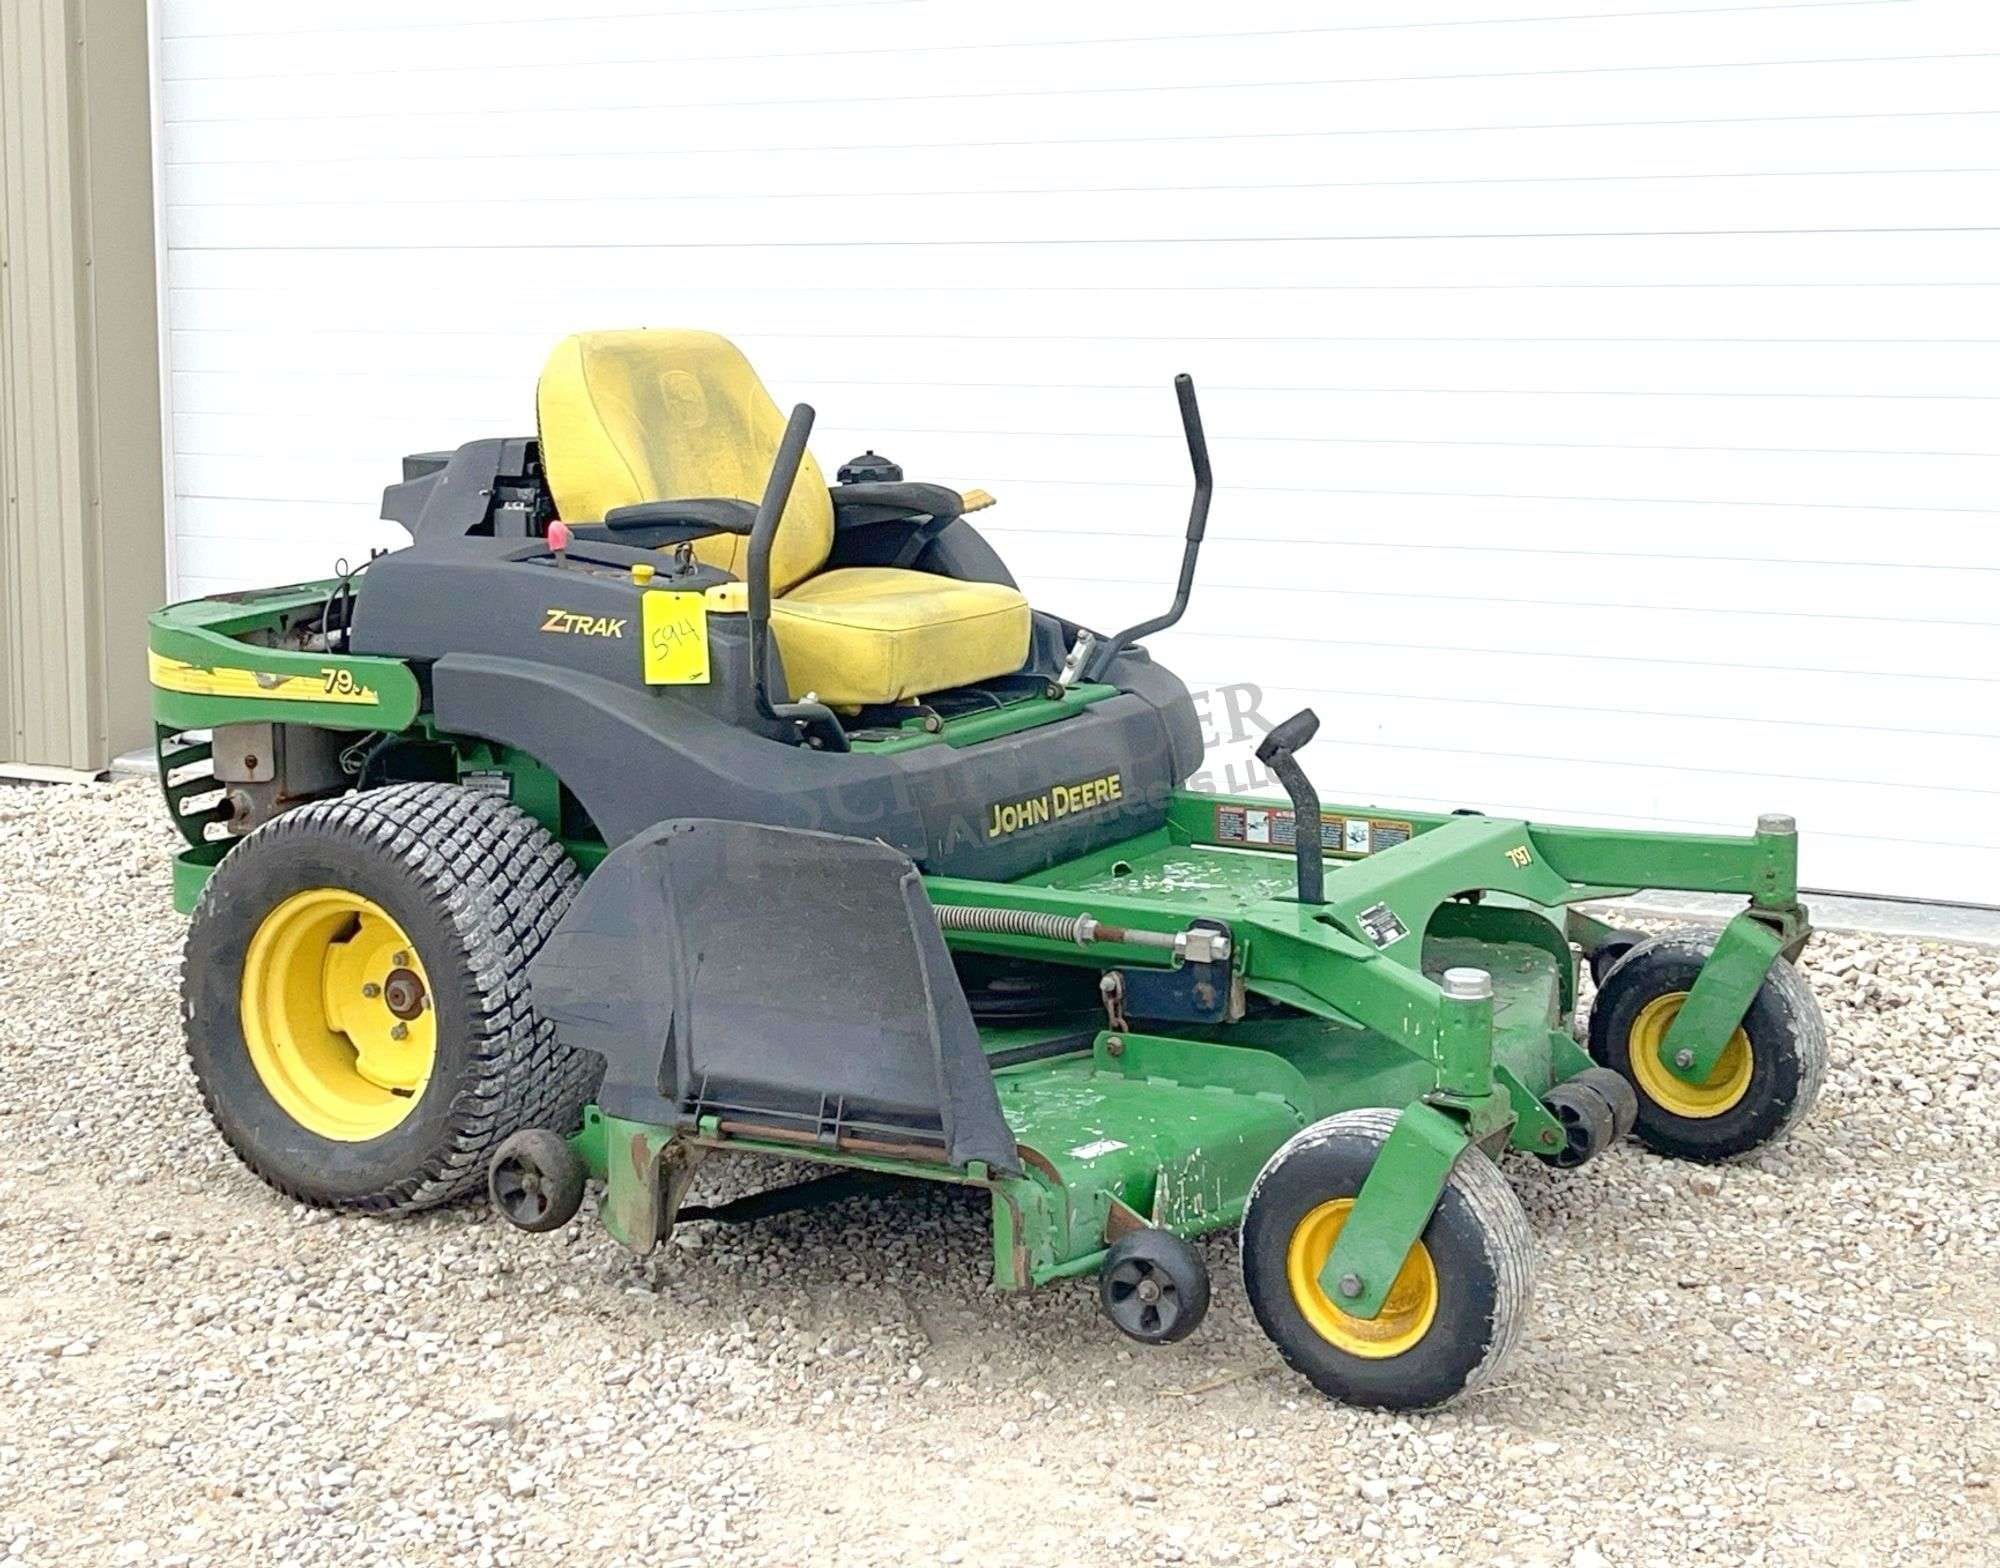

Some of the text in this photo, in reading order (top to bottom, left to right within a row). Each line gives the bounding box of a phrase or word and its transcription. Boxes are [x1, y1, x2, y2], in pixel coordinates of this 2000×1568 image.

[651, 608, 700, 661] 594
[989, 773, 1122, 838] JOHN DEERE
